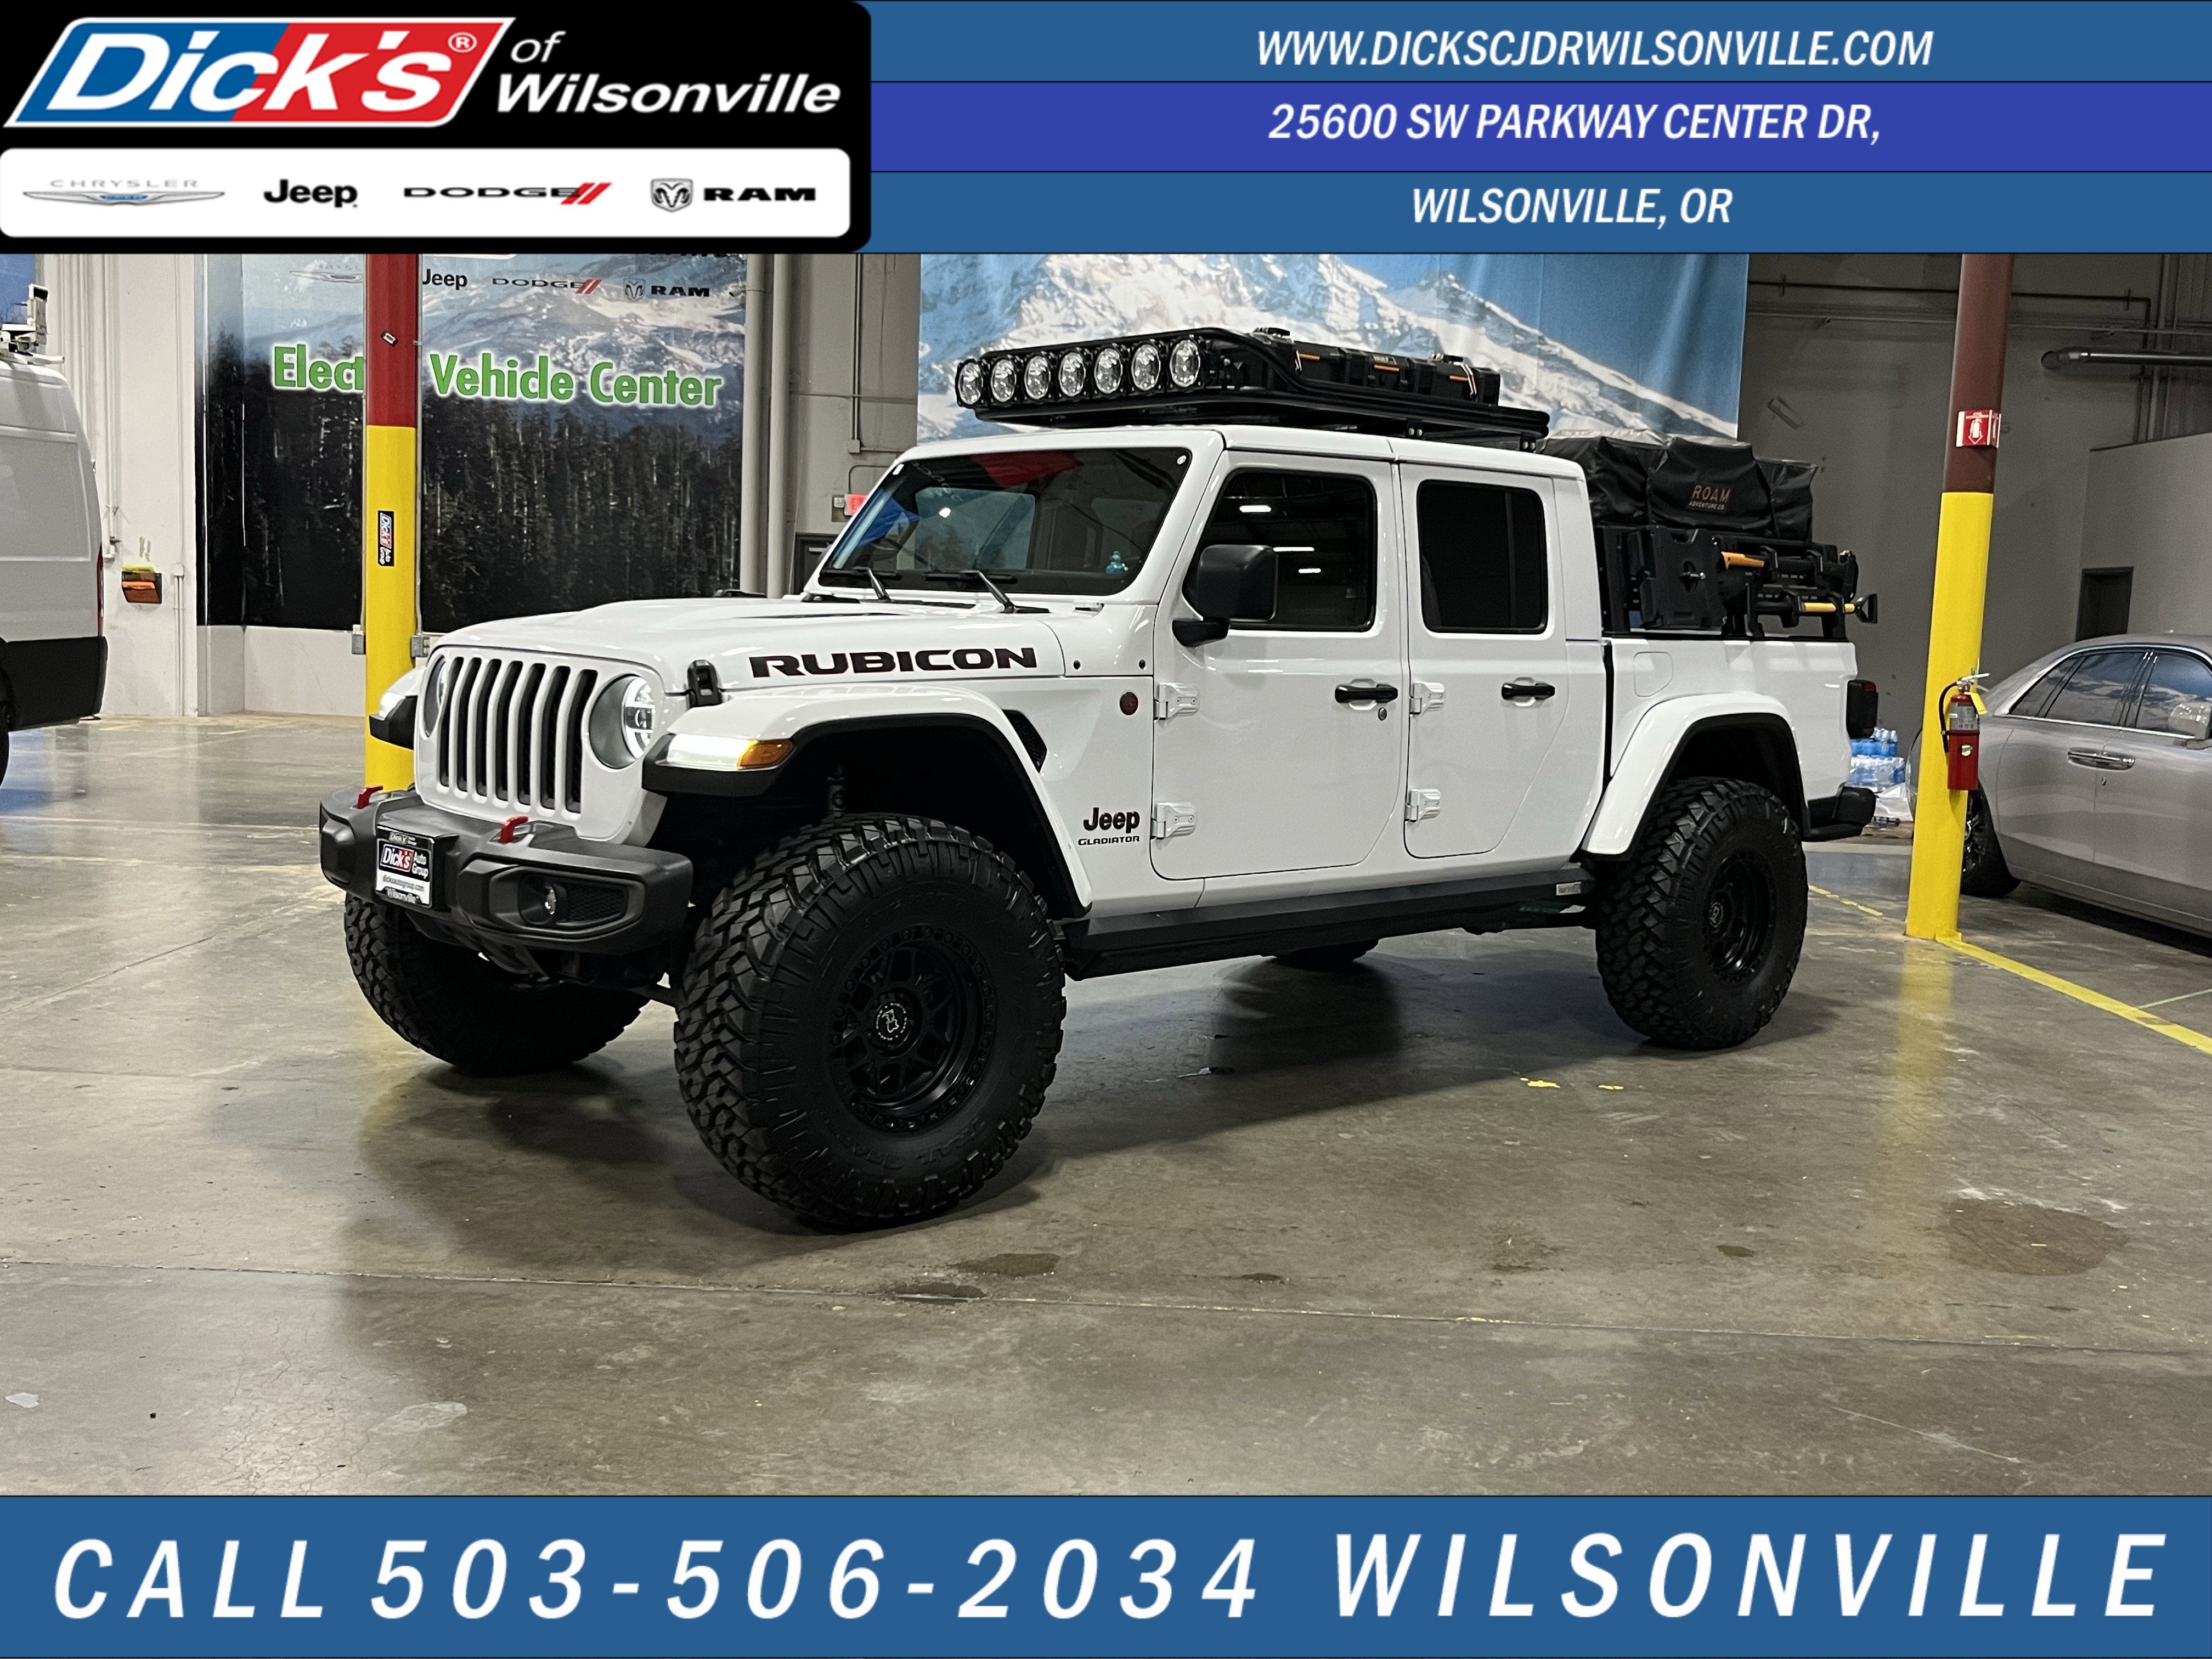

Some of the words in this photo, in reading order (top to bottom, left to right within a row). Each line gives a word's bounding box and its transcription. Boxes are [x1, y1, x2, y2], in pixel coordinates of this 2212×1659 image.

[422, 269, 467, 290] Jeep
[492, 278, 586, 289] DODGE
[651, 285, 710, 297] RAM
[274, 343, 364, 390] Elect
[430, 353, 574, 400] Vehicle
[590, 362, 722, 406] Center
[1692, 484, 1731, 503] ROAM
[748, 647, 1037, 679] RUBICON
[1083, 807, 1140, 834] Jeep
[1077, 836, 1140, 846] GLADIATOR
[382, 847, 411, 869] Dick's
